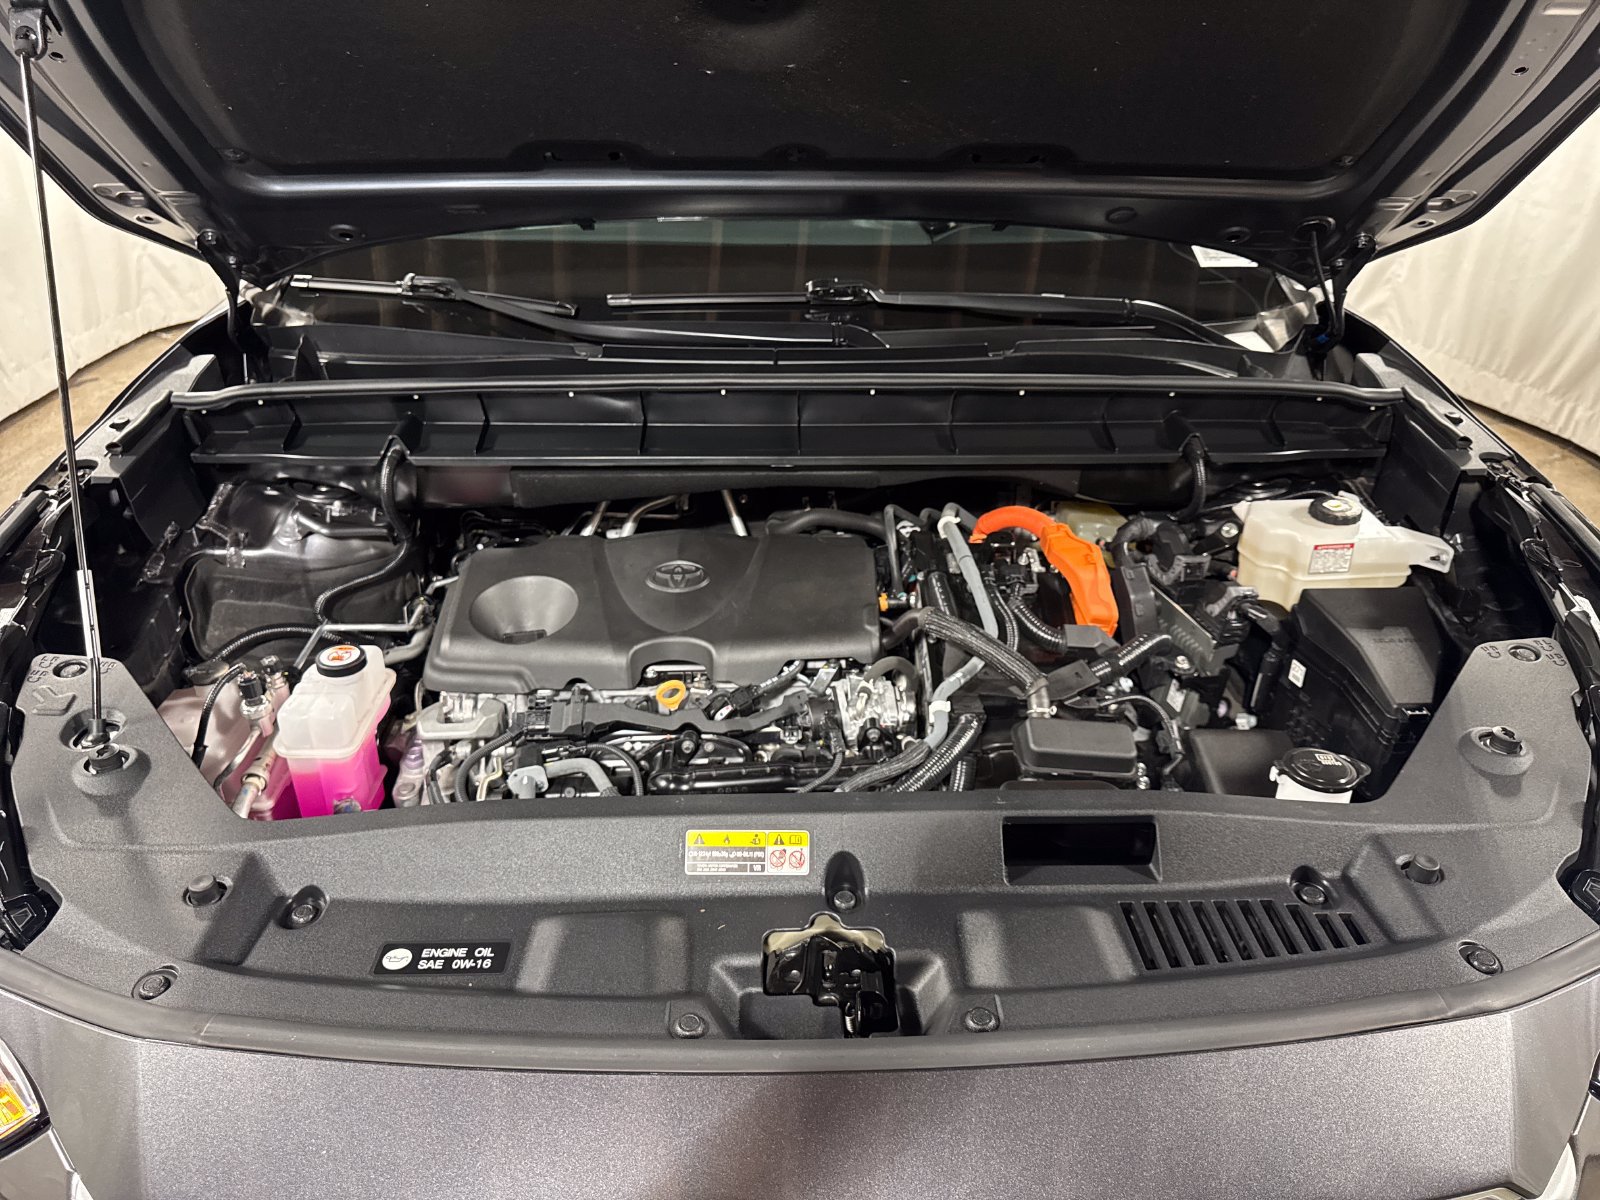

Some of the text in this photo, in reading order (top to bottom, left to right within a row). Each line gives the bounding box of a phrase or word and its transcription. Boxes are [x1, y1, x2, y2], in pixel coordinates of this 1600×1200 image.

[421, 947, 495, 957] ENGINE OIL
[417, 959, 492, 970] SAE 0W-16
